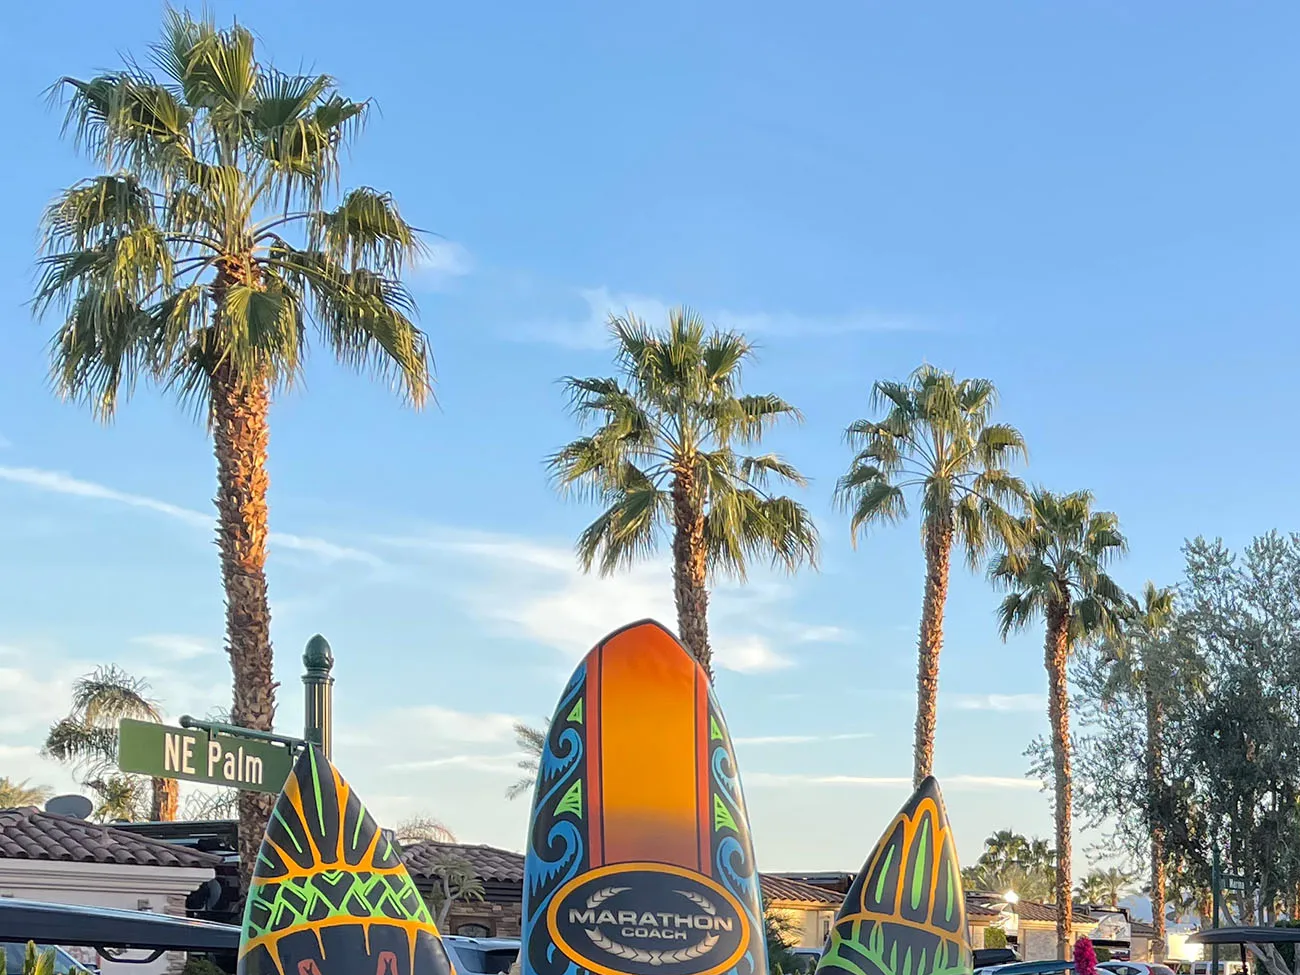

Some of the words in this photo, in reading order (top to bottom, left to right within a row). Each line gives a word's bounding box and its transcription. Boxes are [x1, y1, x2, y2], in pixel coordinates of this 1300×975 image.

[164, 733, 196, 775] NE
[208, 741, 263, 785] Palm
[568, 908, 733, 932] MARATHON
[621, 927, 687, 940] COACH
